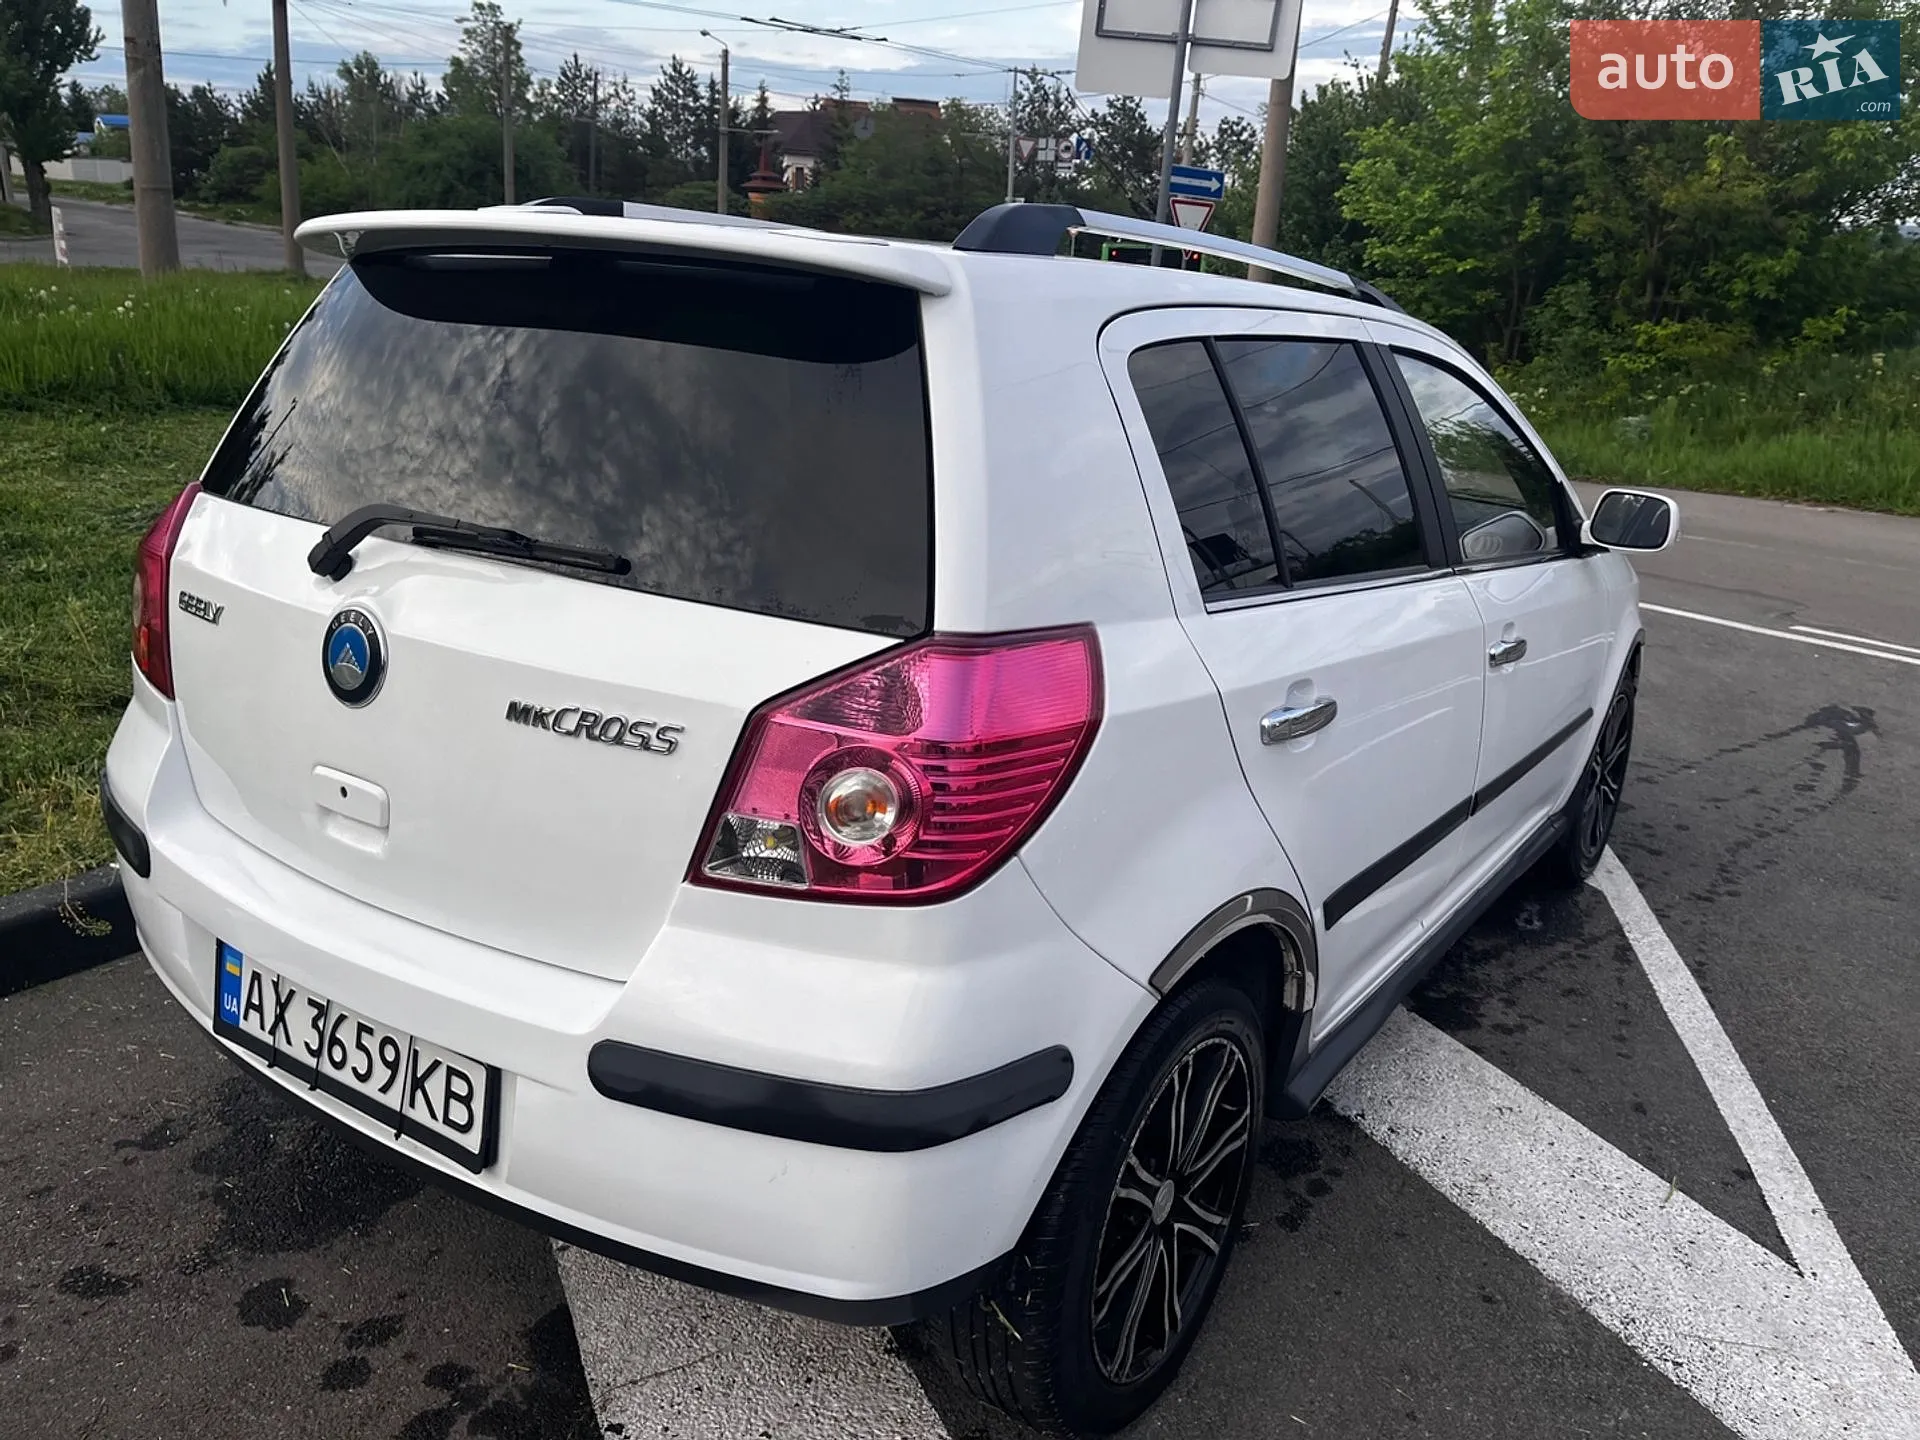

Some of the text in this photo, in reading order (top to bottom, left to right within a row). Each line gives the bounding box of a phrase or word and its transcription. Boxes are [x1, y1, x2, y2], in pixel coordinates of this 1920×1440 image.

[179, 590, 224, 626] GEELY
[331, 611, 374, 635] GEELY
[224, 992, 239, 1015] UA
[243, 969, 475, 1134] AX 3659 KB
